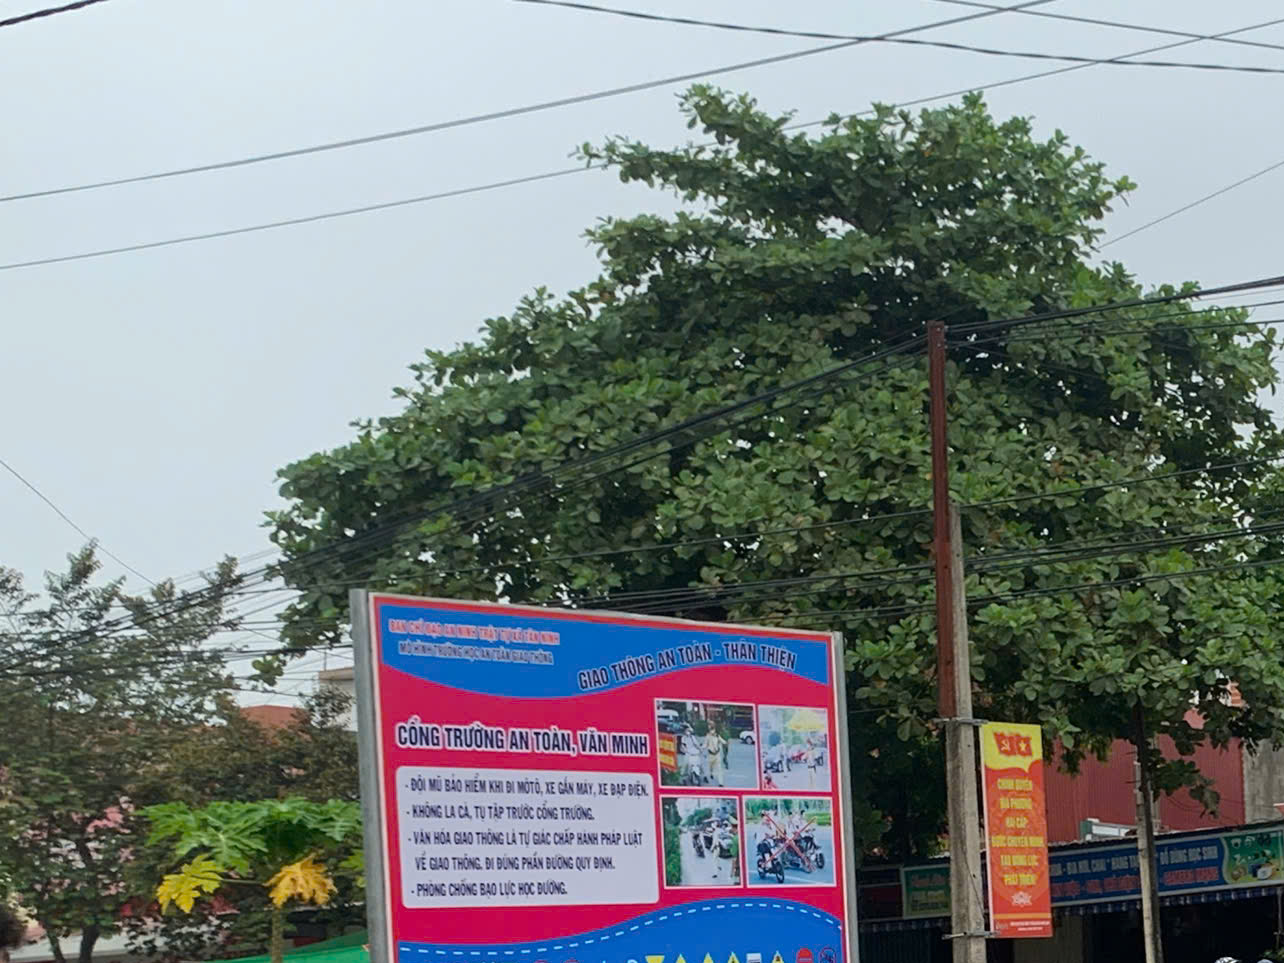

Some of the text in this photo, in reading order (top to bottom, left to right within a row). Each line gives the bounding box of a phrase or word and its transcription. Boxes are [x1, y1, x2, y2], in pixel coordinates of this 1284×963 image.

[578, 638, 798, 691] GIAO THÔNG AN TOÀN THÂN THIỆN
[397, 715, 650, 756] CỔNG TRƯỜNG AN TOÀN, VĂN MINH
[489, 779, 504, 793] KHI
[506, 780, 515, 794] ĐI
[545, 781, 555, 794] XE
[598, 782, 608, 796] XE
[412, 801, 442, 818] KHÔNG
[445, 805, 455, 819] LA
[454, 832, 473, 845] GIAO
[475, 828, 504, 845] THÔNG
[429, 857, 449, 870] GIAO
[576, 857, 591, 871] QUY
